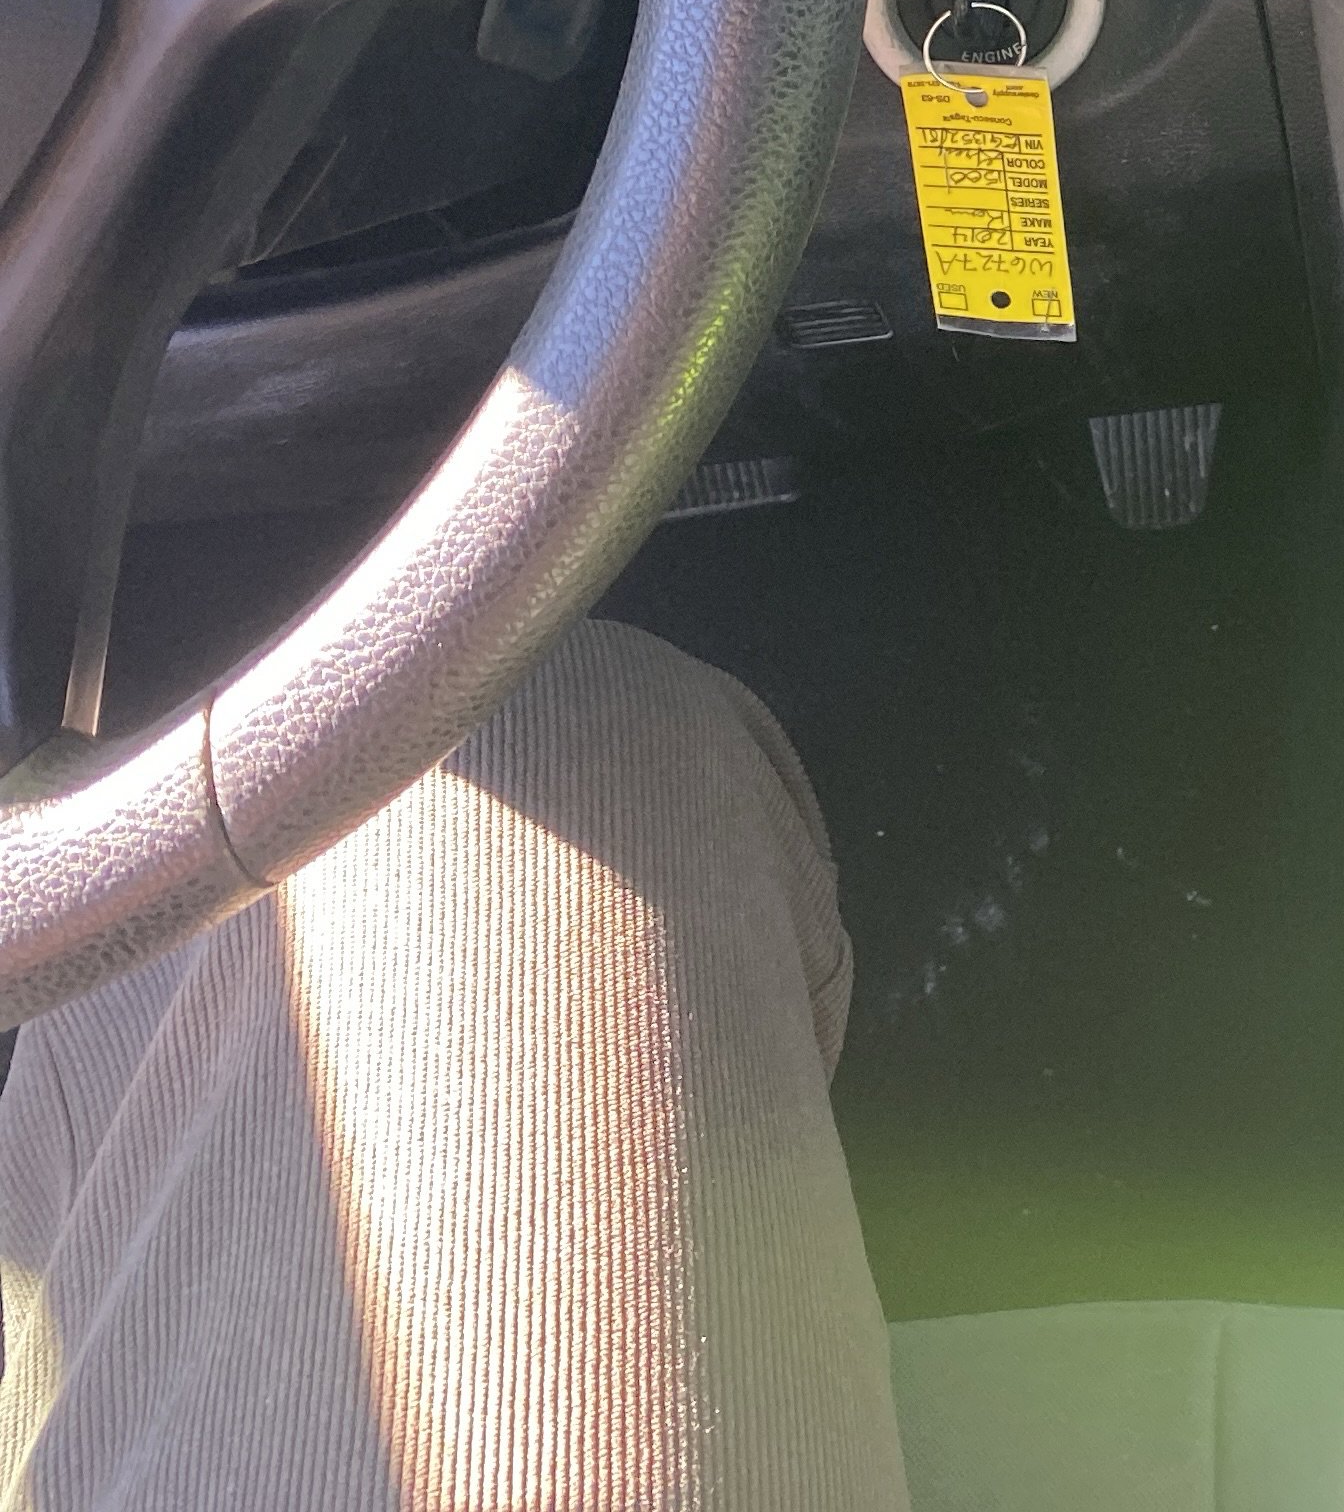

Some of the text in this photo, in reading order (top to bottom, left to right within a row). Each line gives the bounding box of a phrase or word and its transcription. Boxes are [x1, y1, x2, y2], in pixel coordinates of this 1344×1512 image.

[1023, 137, 1044, 150] VIN
[1006, 157, 1046, 170] COLOR
[949, 169, 1003, 185] 1500
[1009, 176, 1048, 189] MODEL
[1010, 196, 1050, 209] SERIES
[1020, 216, 1052, 228] MAKE
[1023, 237, 1055, 248] YEAR
[936, 283, 967, 293] USED
[1032, 290, 1059, 299] NEW
